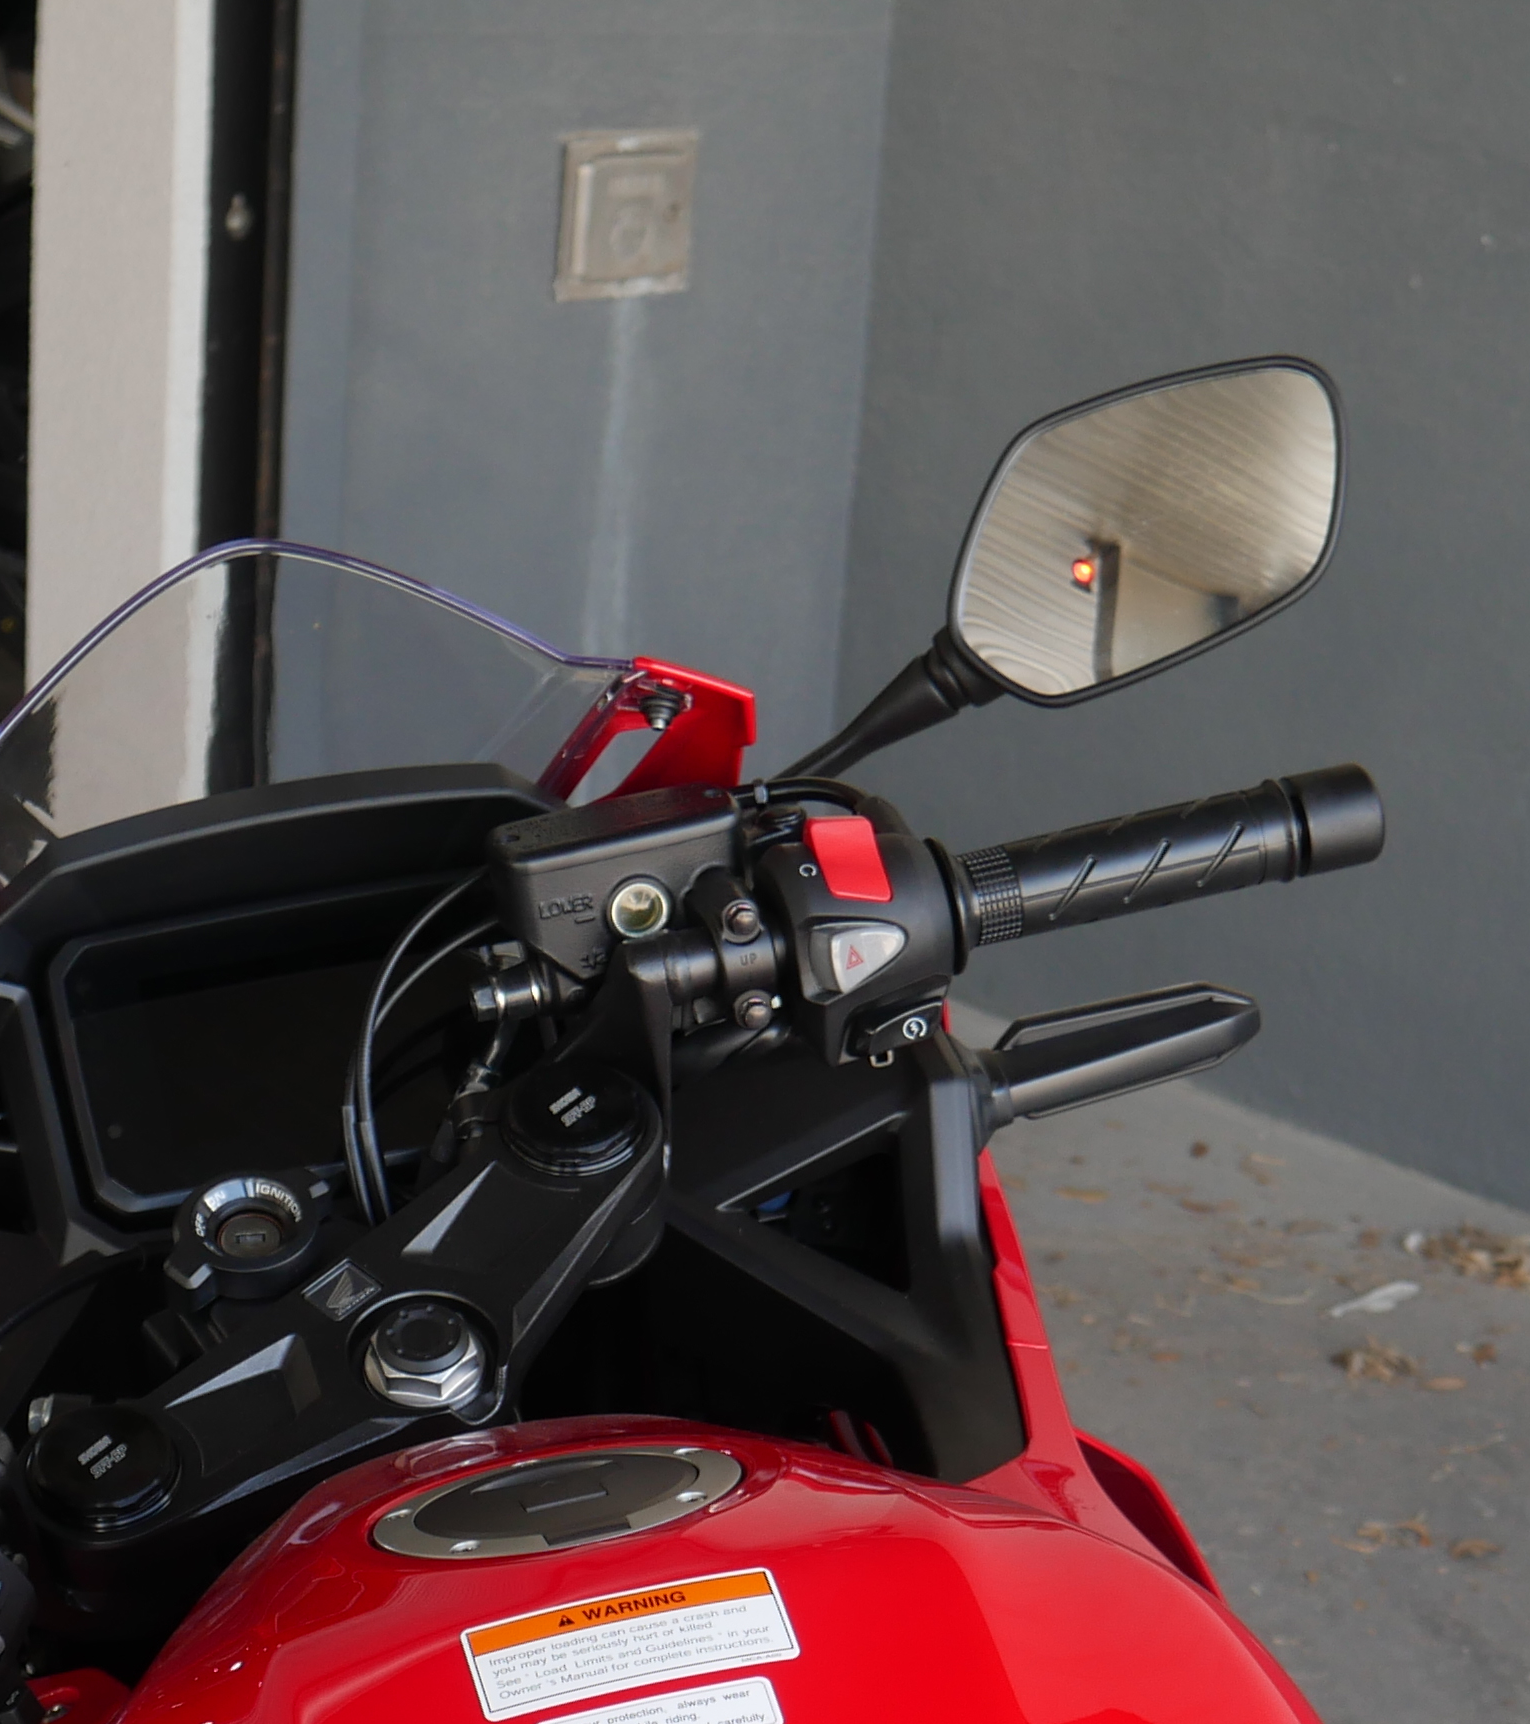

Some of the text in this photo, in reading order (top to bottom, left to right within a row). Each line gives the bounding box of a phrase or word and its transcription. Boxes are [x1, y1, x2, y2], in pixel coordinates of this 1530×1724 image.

[538, 894, 594, 920] LOWER
[739, 952, 758, 966] UP
[206, 1190, 226, 1209] ON
[256, 1182, 302, 1223] IGNITION
[582, 1590, 687, 1621] WARNING
[489, 1645, 547, 1667] Improper
[551, 1634, 598, 1650] loading
[601, 1628, 625, 1639] can
[629, 1620, 668, 1633] cause
[683, 1609, 719, 1622] crash
[723, 1604, 747, 1615] and
[492, 1665, 516, 1679] you
[520, 1656, 547, 1669] may
[551, 1652, 567, 1661] be
[572, 1637, 628, 1656] seriously
[633, 1631, 658, 1643] hurt
[496, 1677, 522, 1689] See
[575, 1655, 614, 1668] Limits
[618, 1648, 642, 1659] and
[728, 1629, 739, 1637] in
[743, 1625, 770, 1638] your
[560, 1666, 609, 1684] Manual
[611, 1662, 629, 1674] for
[633, 1650, 692, 1667] complete
[695, 1636, 774, 1654] instructions.
[677, 1696, 716, 1710] always
[722, 1690, 750, 1701] wear
